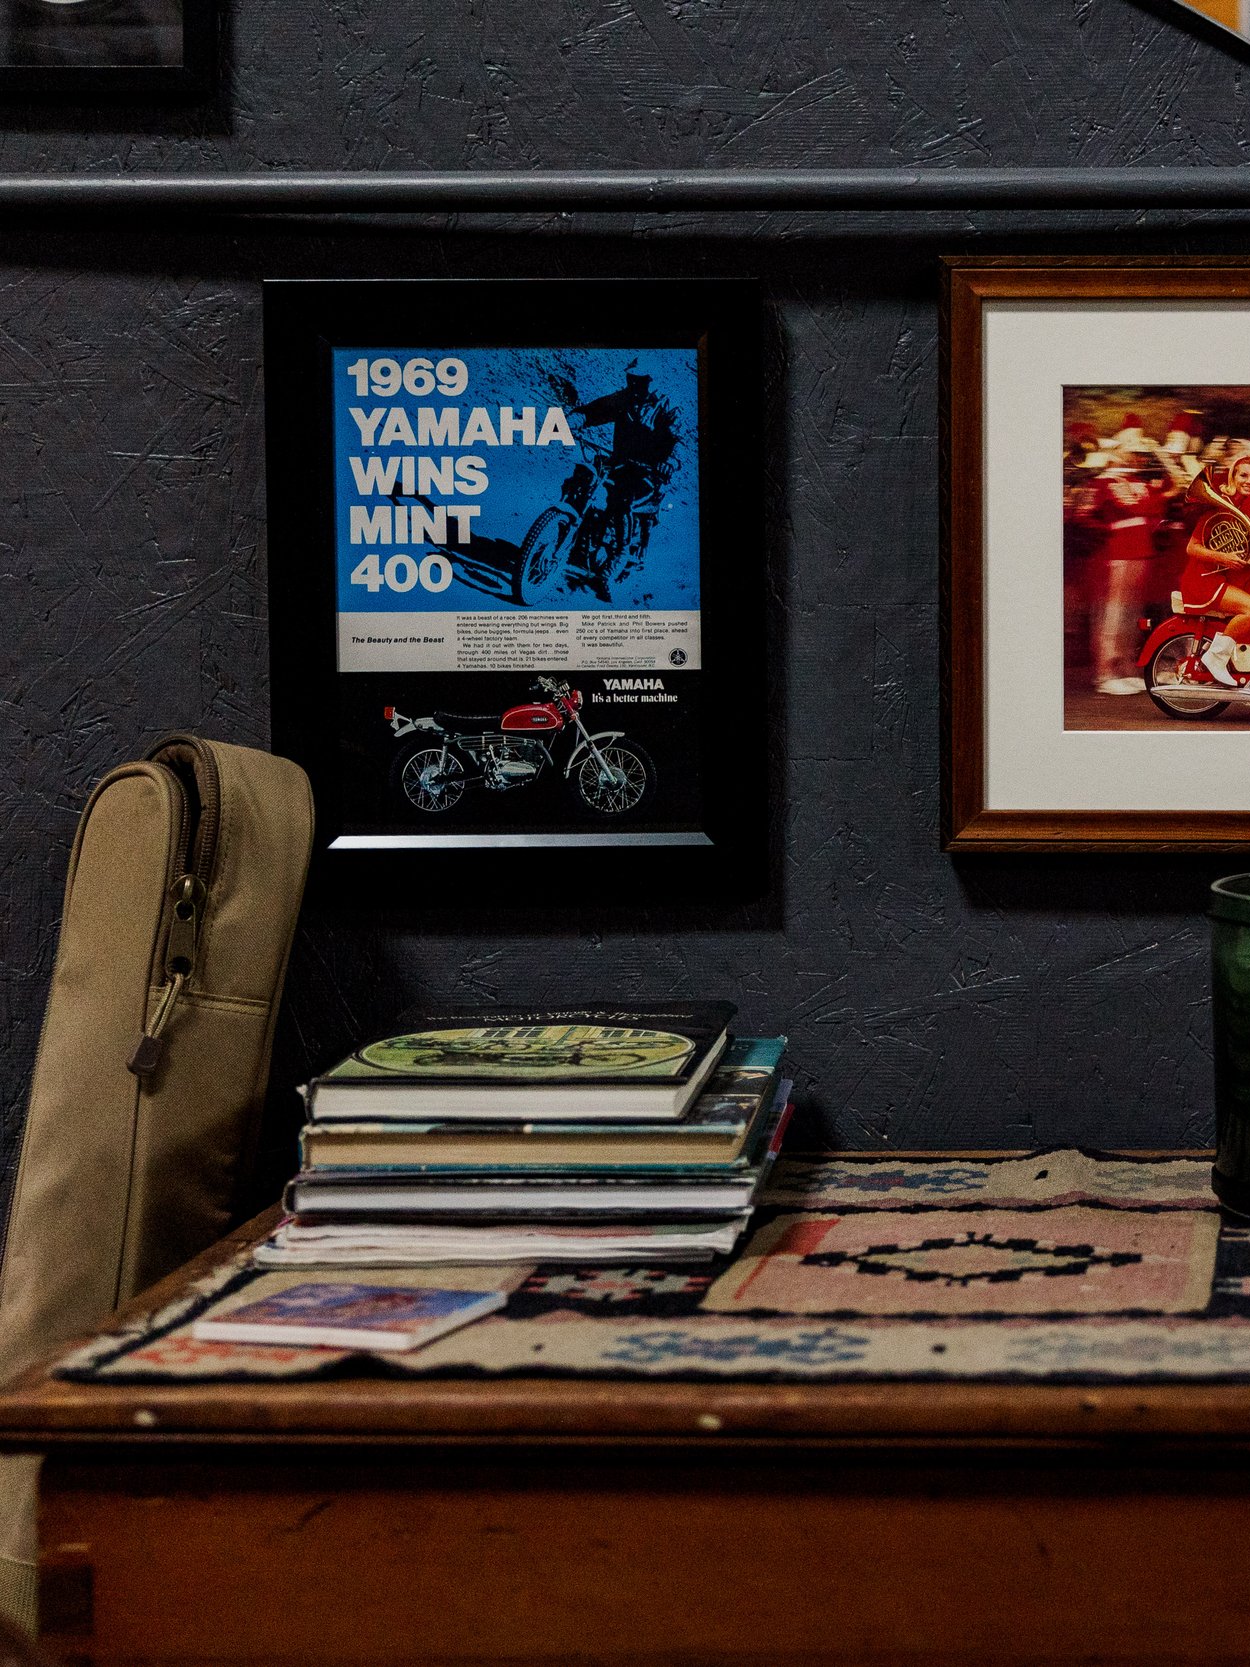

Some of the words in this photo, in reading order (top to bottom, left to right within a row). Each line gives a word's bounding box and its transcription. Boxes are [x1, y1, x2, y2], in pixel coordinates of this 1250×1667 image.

[347, 357, 469, 397] 1969
[348, 406, 576, 446] YAMAHA
[348, 455, 489, 496] WINS
[350, 506, 481, 545] MINT
[350, 554, 453, 593] 400
[367, 637, 392, 645] Beauty
[592, 692, 604, 703] It's
[606, 694, 611, 703] a
[613, 692, 639, 703] better
[641, 692, 679, 703] machine
[603, 678, 665, 690] YAMAHA
